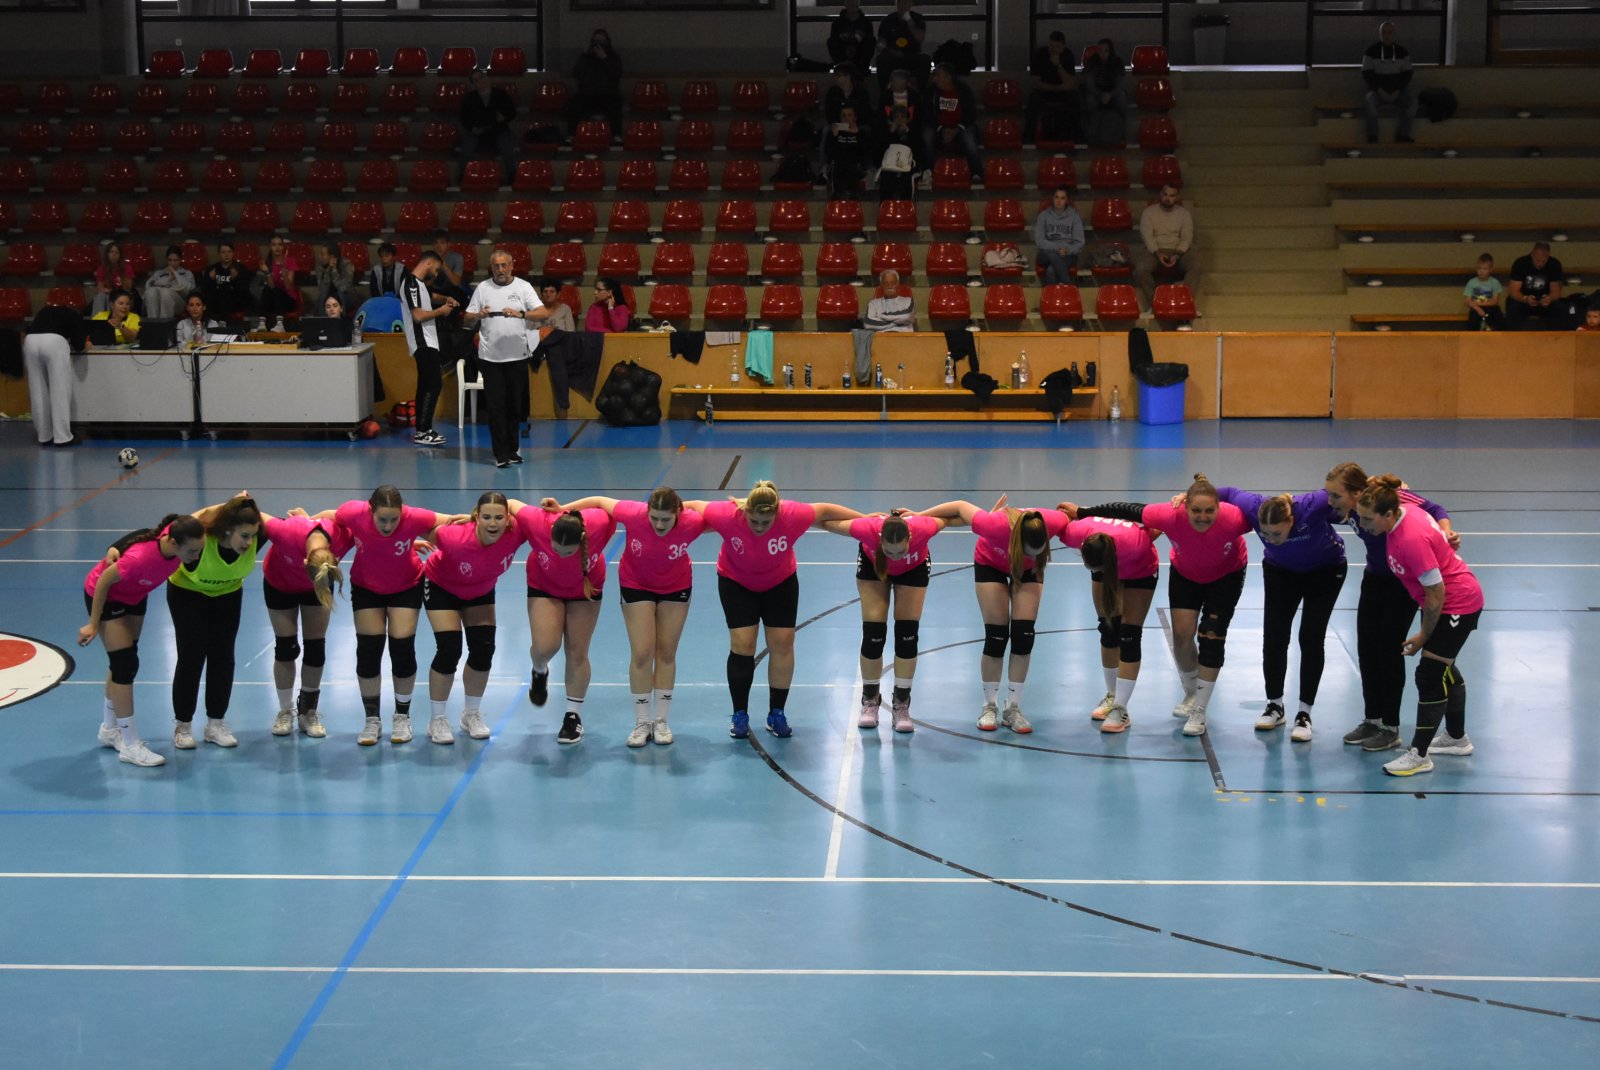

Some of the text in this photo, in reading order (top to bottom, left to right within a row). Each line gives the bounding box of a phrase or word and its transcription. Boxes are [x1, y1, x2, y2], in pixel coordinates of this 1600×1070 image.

[394, 538, 411, 556] 31
[668, 542, 688, 560] 36
[767, 535, 788, 556] 66
[903, 551, 919, 565] 11
